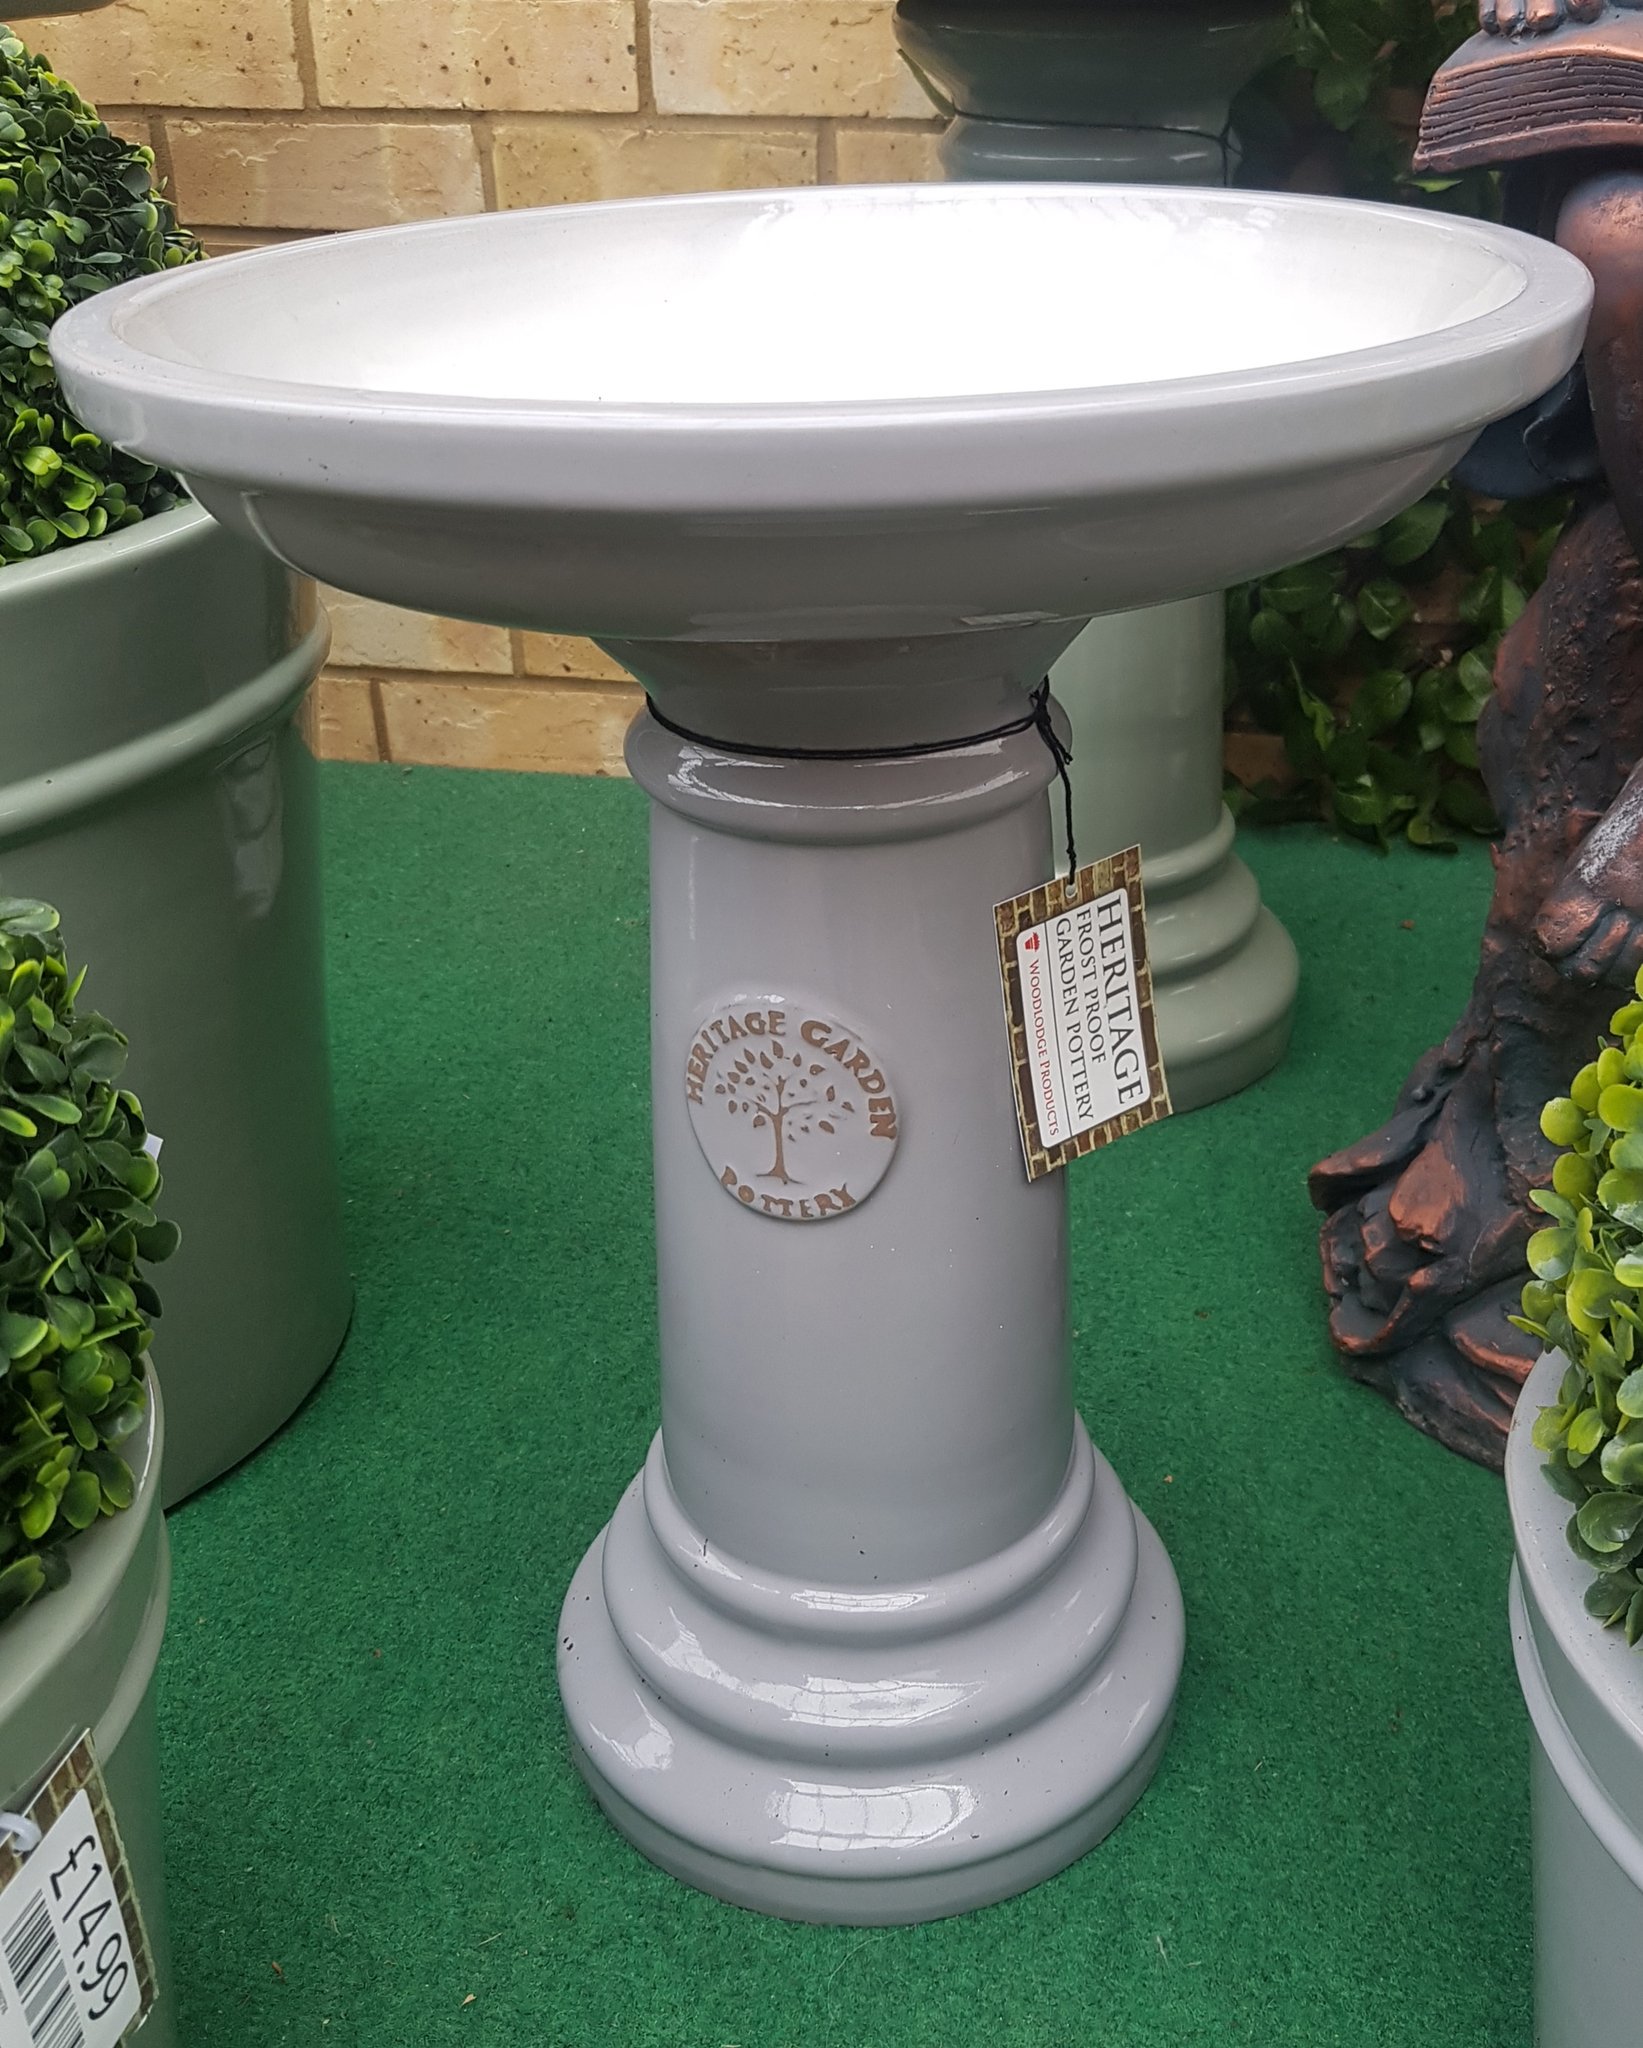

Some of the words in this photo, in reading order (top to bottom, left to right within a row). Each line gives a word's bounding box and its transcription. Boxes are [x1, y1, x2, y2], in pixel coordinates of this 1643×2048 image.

[1056, 917, 1080, 1013] GARDEN
[1076, 908, 1098, 981] FROST
[1029, 959, 1047, 1058] WOODLODGE
[1041, 1060, 1060, 1136] PRODUCTS
[1084, 987, 1108, 1064] PROOF
[1097, 895, 1144, 1104] HERITAGE
[686, 1010, 787, 1105] HERITAGE
[800, 1019, 898, 1141] GARDEN
[1067, 1023, 1094, 1121] POTTERY
[720, 1165, 857, 1218] POTTERY
[50, 1835, 129, 2021] £14.99
